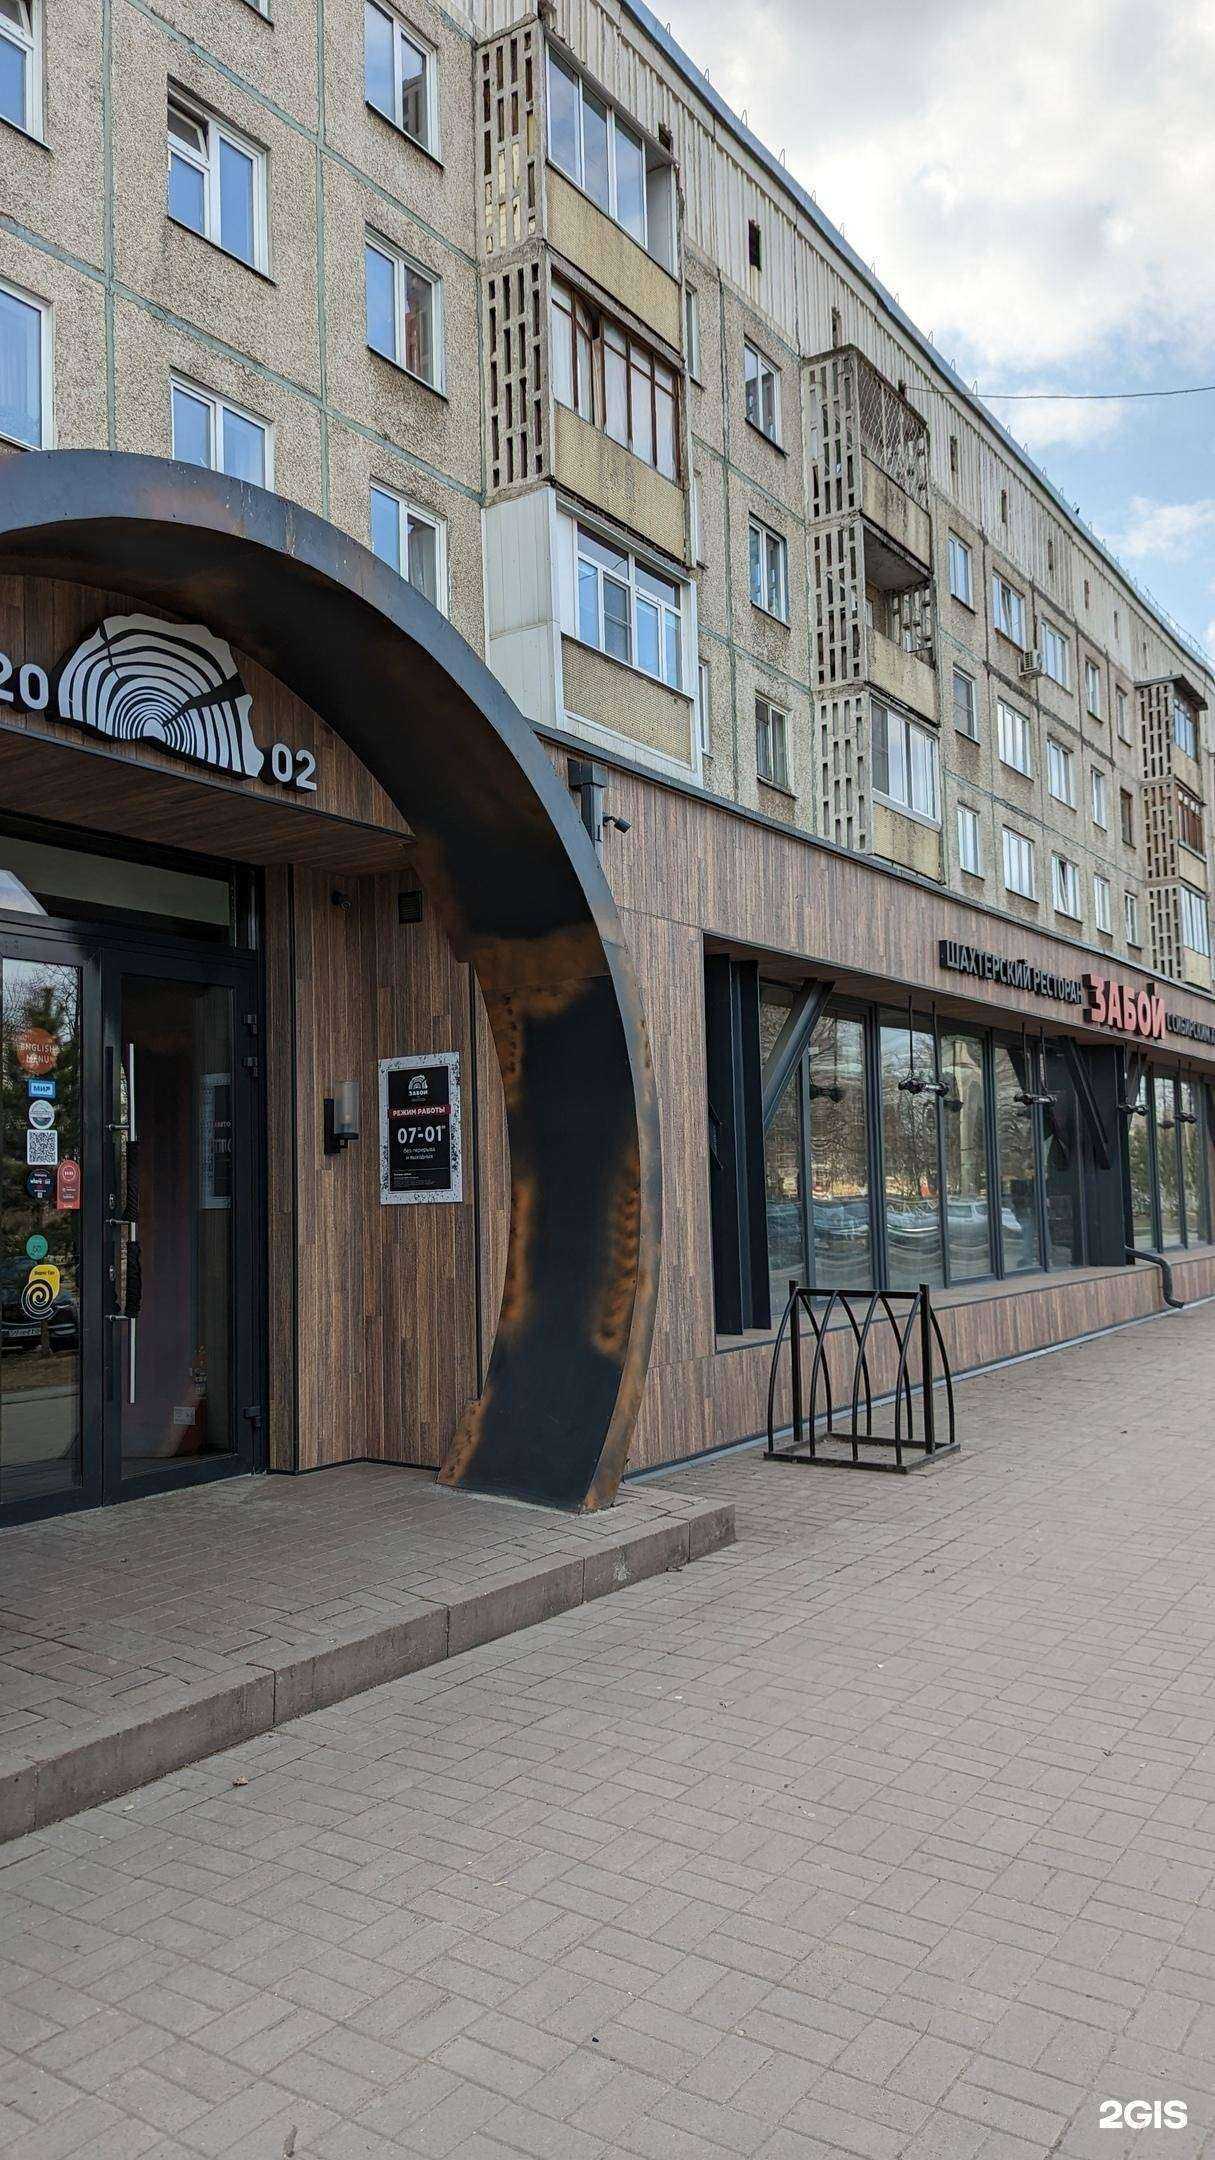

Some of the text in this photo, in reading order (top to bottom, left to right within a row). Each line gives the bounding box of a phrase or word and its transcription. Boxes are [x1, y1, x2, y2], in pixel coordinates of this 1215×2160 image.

[271, 743, 317, 790] 02
[946, 940, 1030, 991] ШАХТЕРСКИЙ
[1033, 967, 1082, 1005] РЕСТОРАН
[1089, 973, 1166, 1040] ЗАБОЙ
[19, 1043, 57, 1054] ENGLISH
[392, 1106, 446, 1117] РЕЖИМ РАБОТЫ
